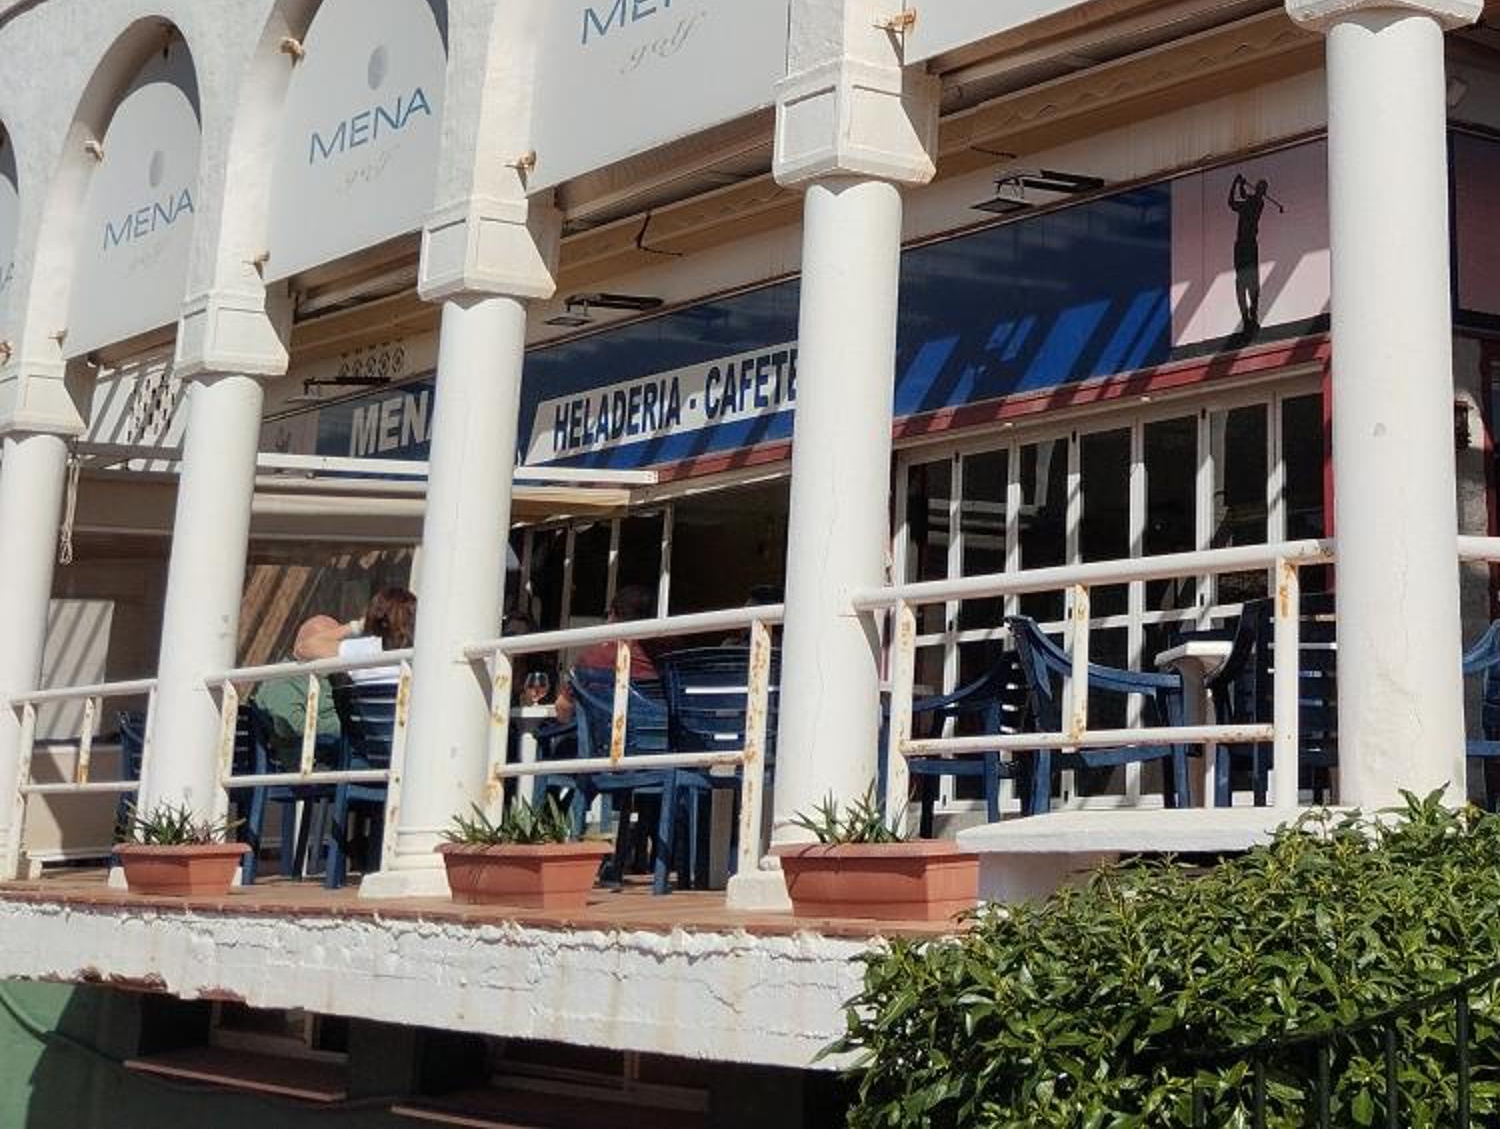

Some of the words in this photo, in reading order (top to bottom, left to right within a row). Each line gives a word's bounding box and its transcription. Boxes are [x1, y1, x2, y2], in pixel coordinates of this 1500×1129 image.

[309, 87, 433, 165] MENA
[102, 188, 195, 251] MENA
[350, 390, 433, 459] MEN
[553, 375, 681, 453] HELADERIA
